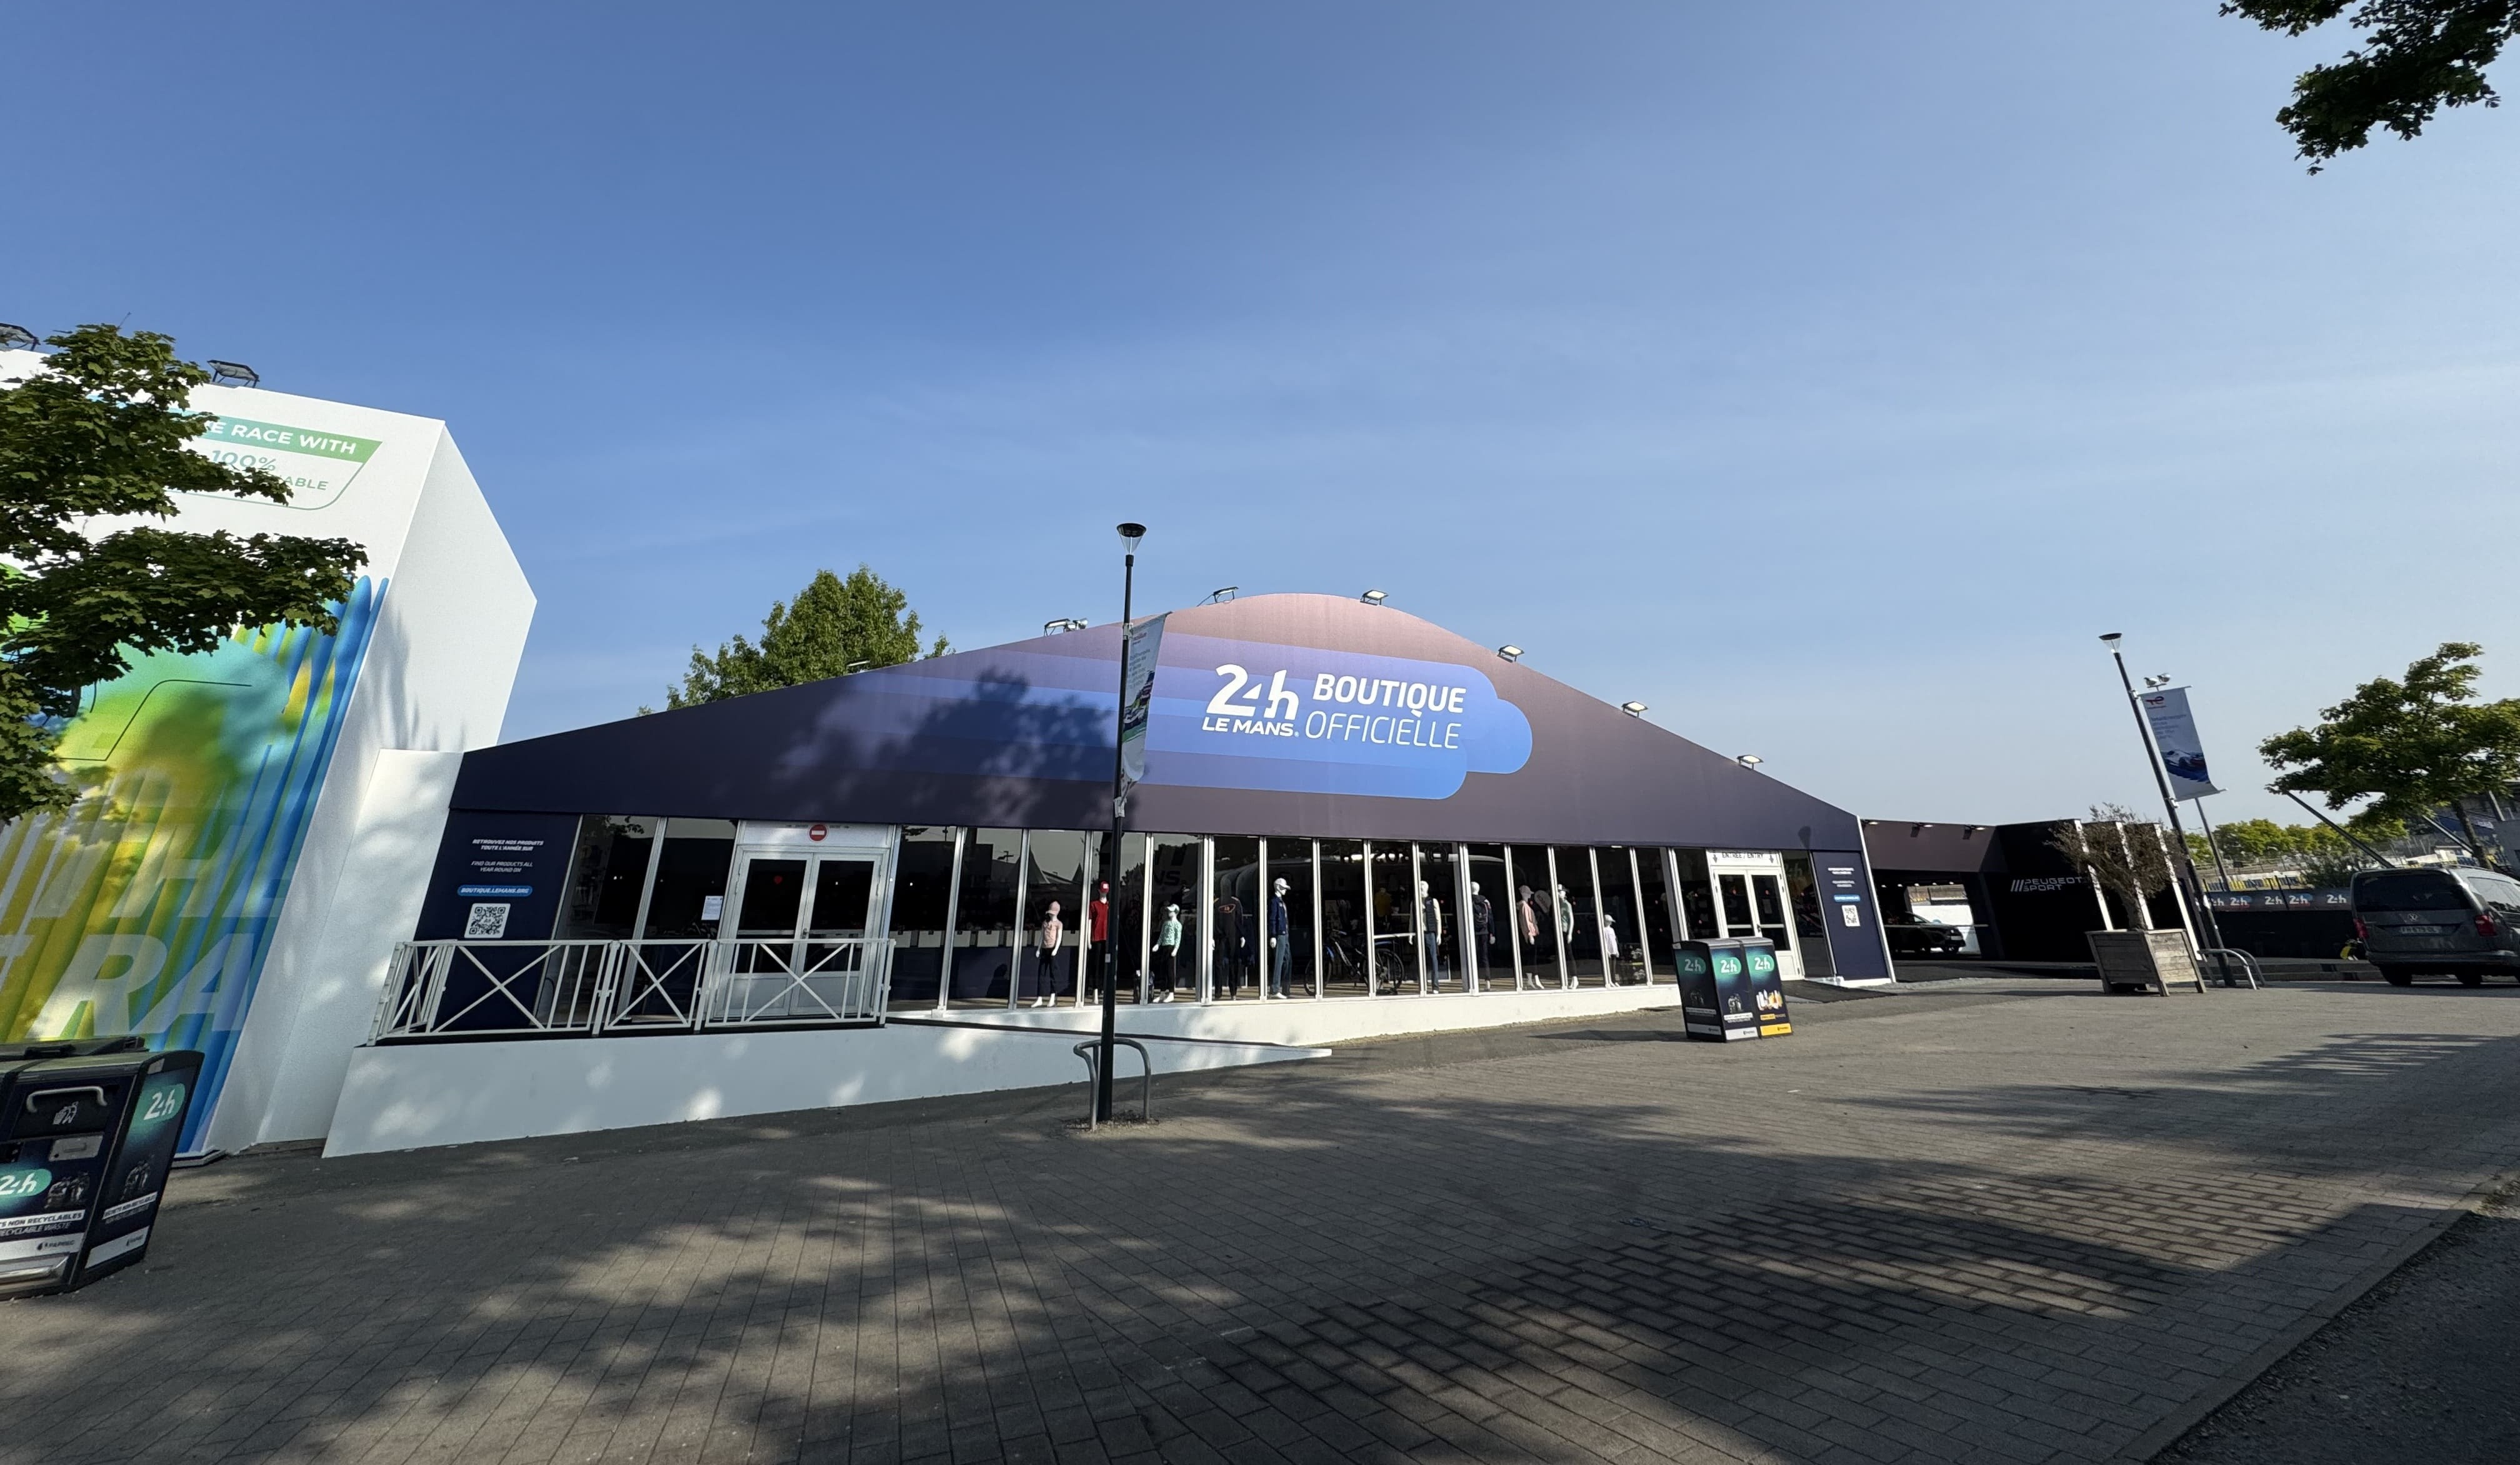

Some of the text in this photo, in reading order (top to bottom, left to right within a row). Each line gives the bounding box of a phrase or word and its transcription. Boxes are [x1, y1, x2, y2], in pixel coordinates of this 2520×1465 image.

[231, 424, 293, 444] RACE
[299, 434, 356, 454] WITH
[212, 450, 276, 471] 100%
[1206, 664, 1299, 720] 24h
[1312, 672, 1466, 718] BOUTIQUE
[1202, 716, 1228, 732] LE
[1305, 711, 1462, 749] OFFICIELLE
[2023, 884, 2062, 892] SPORT
[2024, 876, 2082, 885] PEUGEOT
[2230, 897, 2248, 906] 24h
[2289, 895, 2308, 904] 24h
[2326, 894, 2347, 904] 24h
[1684, 958, 1701, 972] 24h
[1720, 959, 1738, 973] 24h
[1754, 956, 1771, 971] 24h
[143, 1089, 176, 1121] 24h
[27, 1212, 82, 1224] RECYCLABLES
[43, 1222, 71, 1231] WASTE
